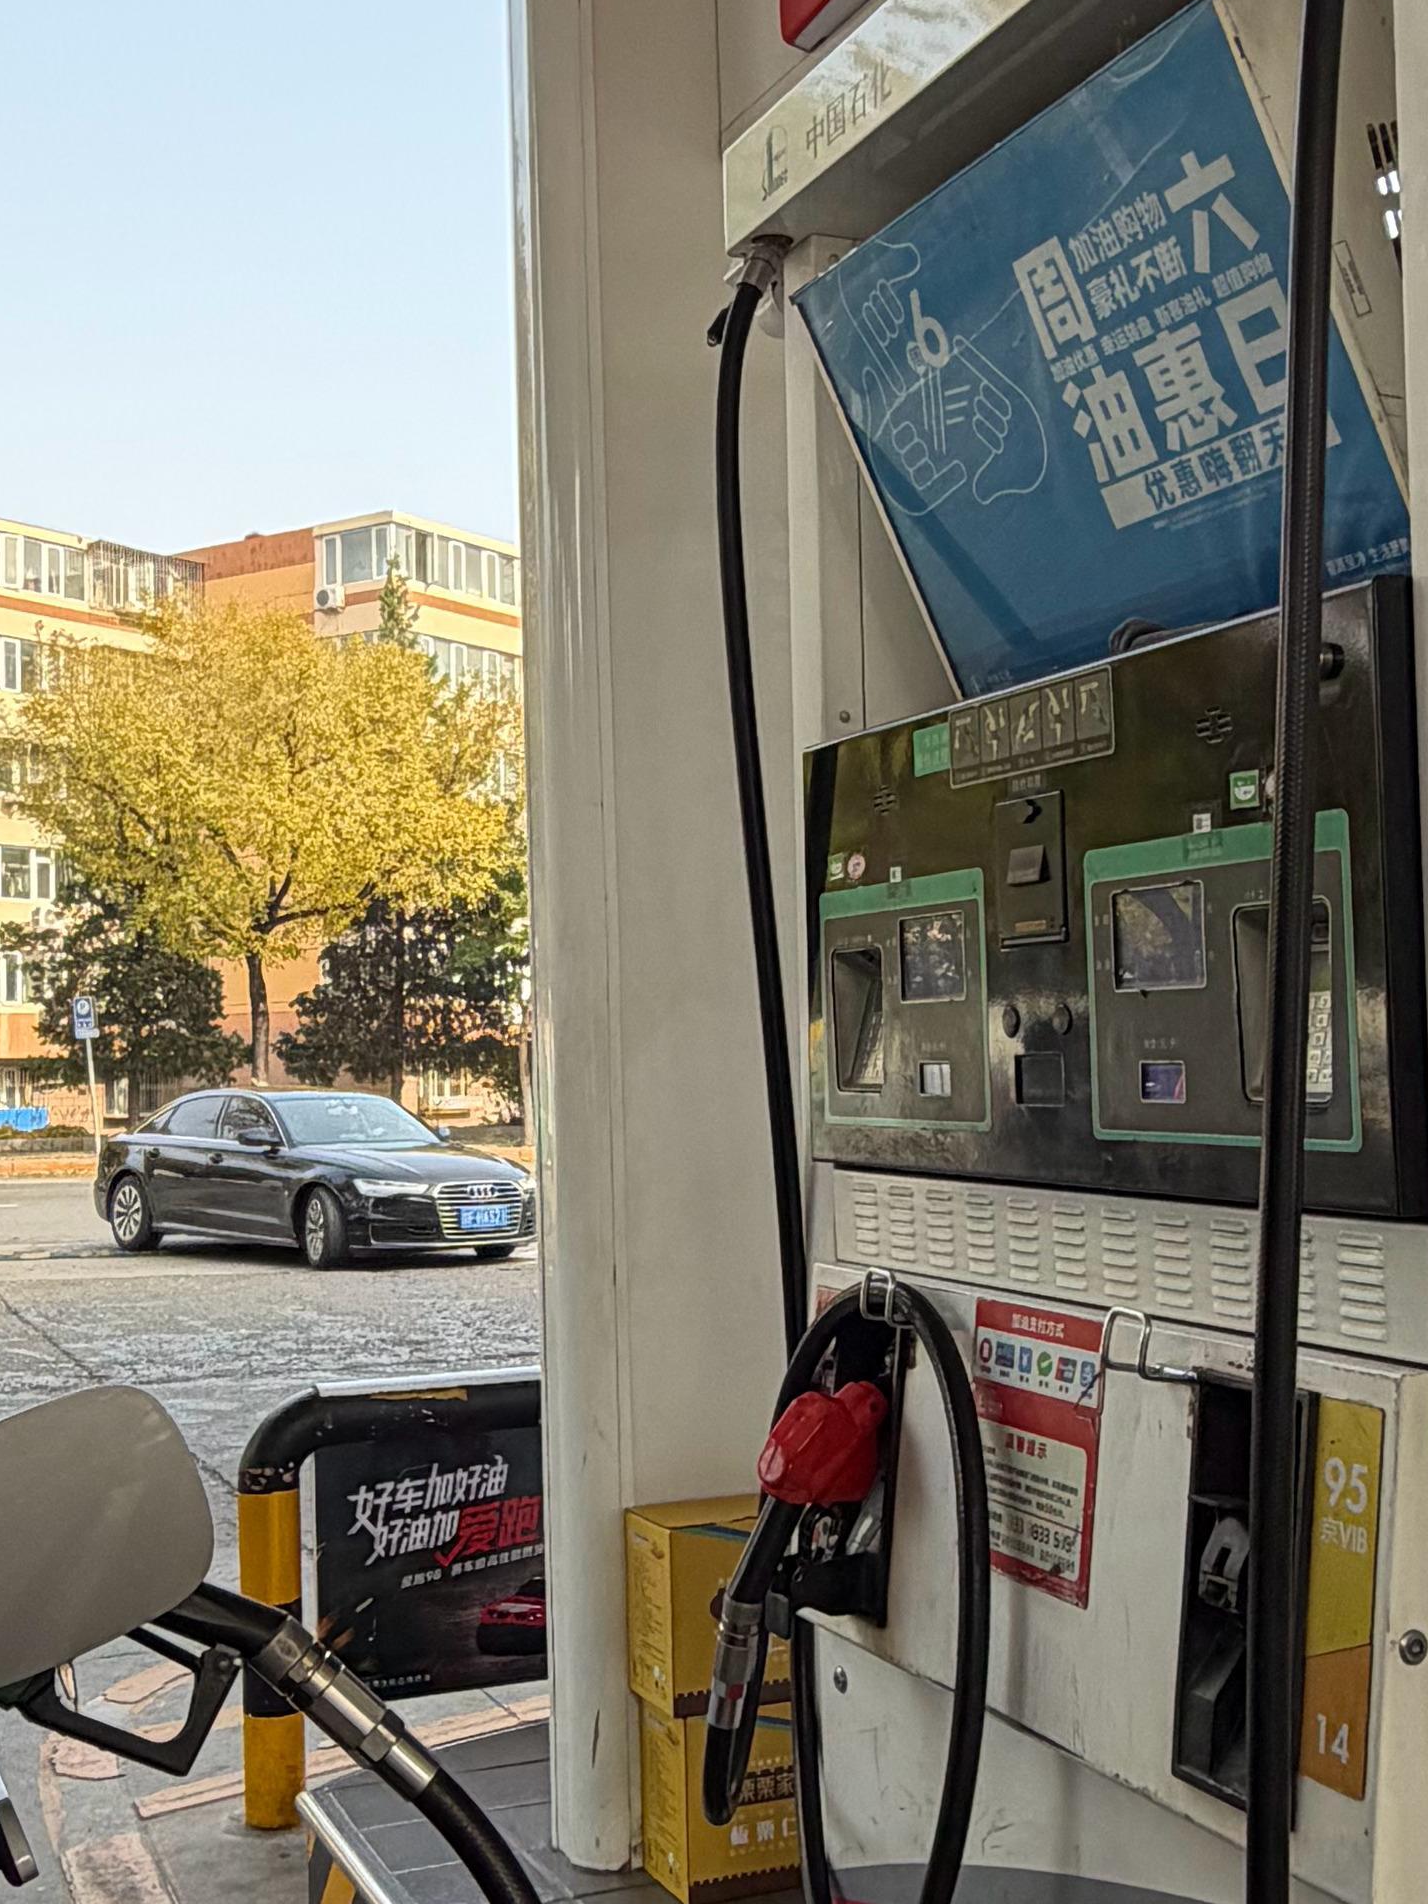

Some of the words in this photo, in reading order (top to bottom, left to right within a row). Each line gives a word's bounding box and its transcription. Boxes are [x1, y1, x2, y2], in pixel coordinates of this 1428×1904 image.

[806, 59, 892, 160] 中国石化
[1012, 236, 1098, 360] 周
[1164, 151, 1260, 274] 六
[1068, 191, 1169, 275] 加油购物
[1086, 235, 1189, 321] 豪礼不断
[1062, 277, 1290, 484] 油惠日
[347, 1454, 509, 1536] 好车加好油
[1323, 1456, 1369, 1514] 95
[365, 1496, 542, 1568] 好油加爱跑
[1320, 1517, 1368, 1555] 京VIB
[1317, 1713, 1350, 1765] 14
